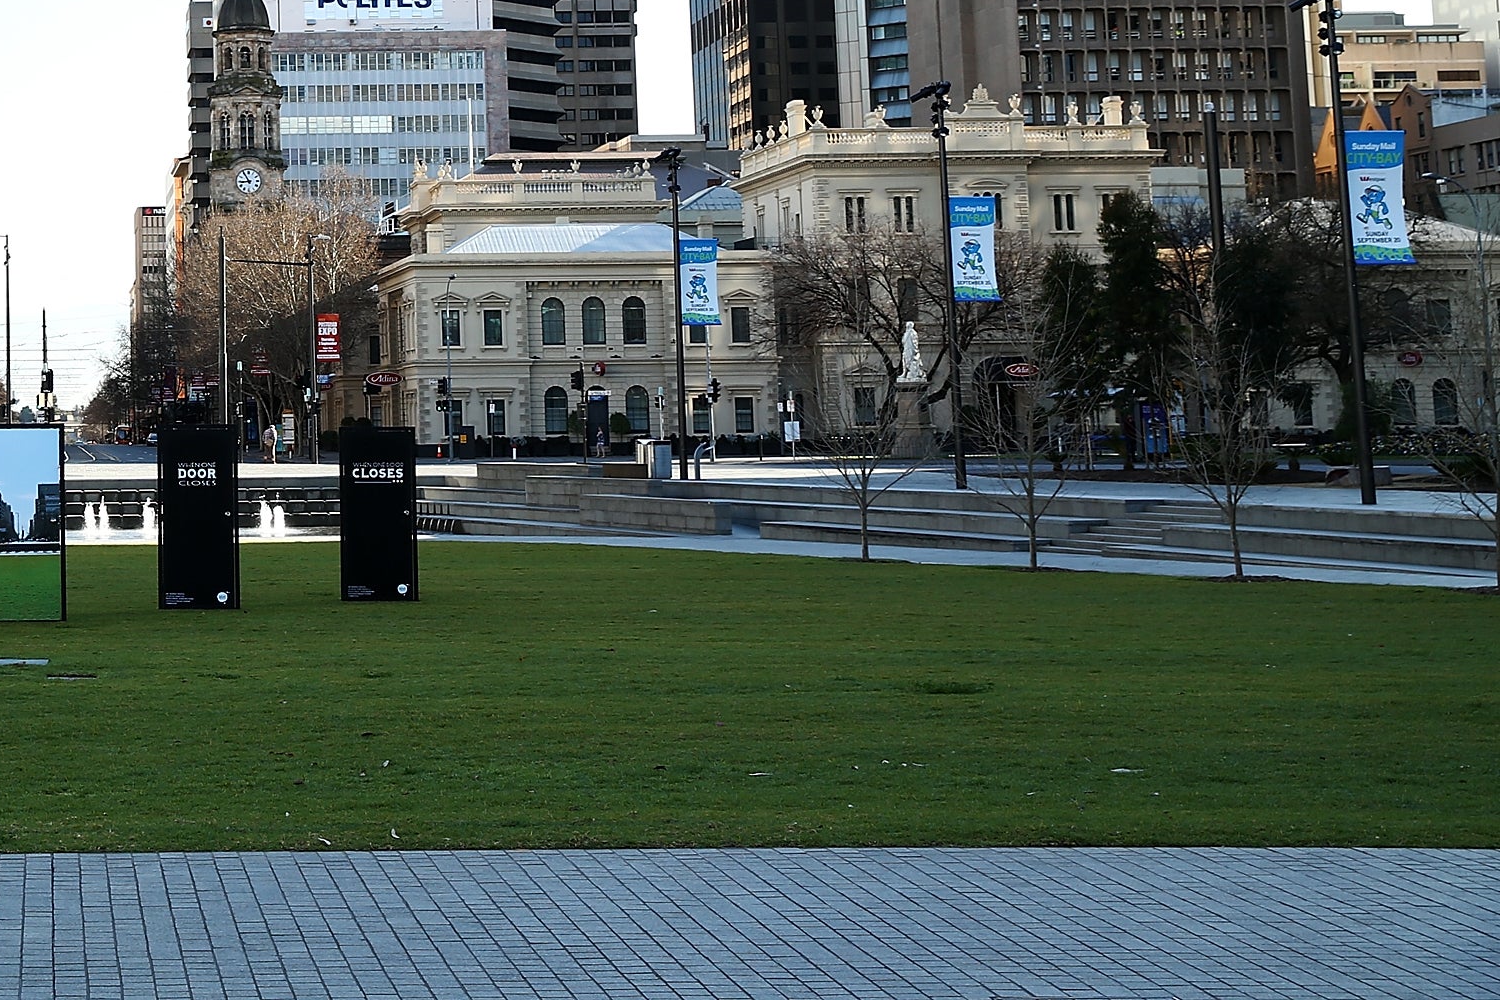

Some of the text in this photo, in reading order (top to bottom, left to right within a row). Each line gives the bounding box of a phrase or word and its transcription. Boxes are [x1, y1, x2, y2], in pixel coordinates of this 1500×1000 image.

[1352, 142, 1396, 151] Sunday Mail
[1346, 152, 1401, 164] CITY-BAY
[950, 213, 992, 223] CITY-BAY
[680, 252, 715, 260] CITY-BAY
[318, 327, 338, 336] EXPO
[371, 374, 398, 383] Adina
[177, 468, 217, 479] DOOR
[352, 468, 404, 478] CLOSES
